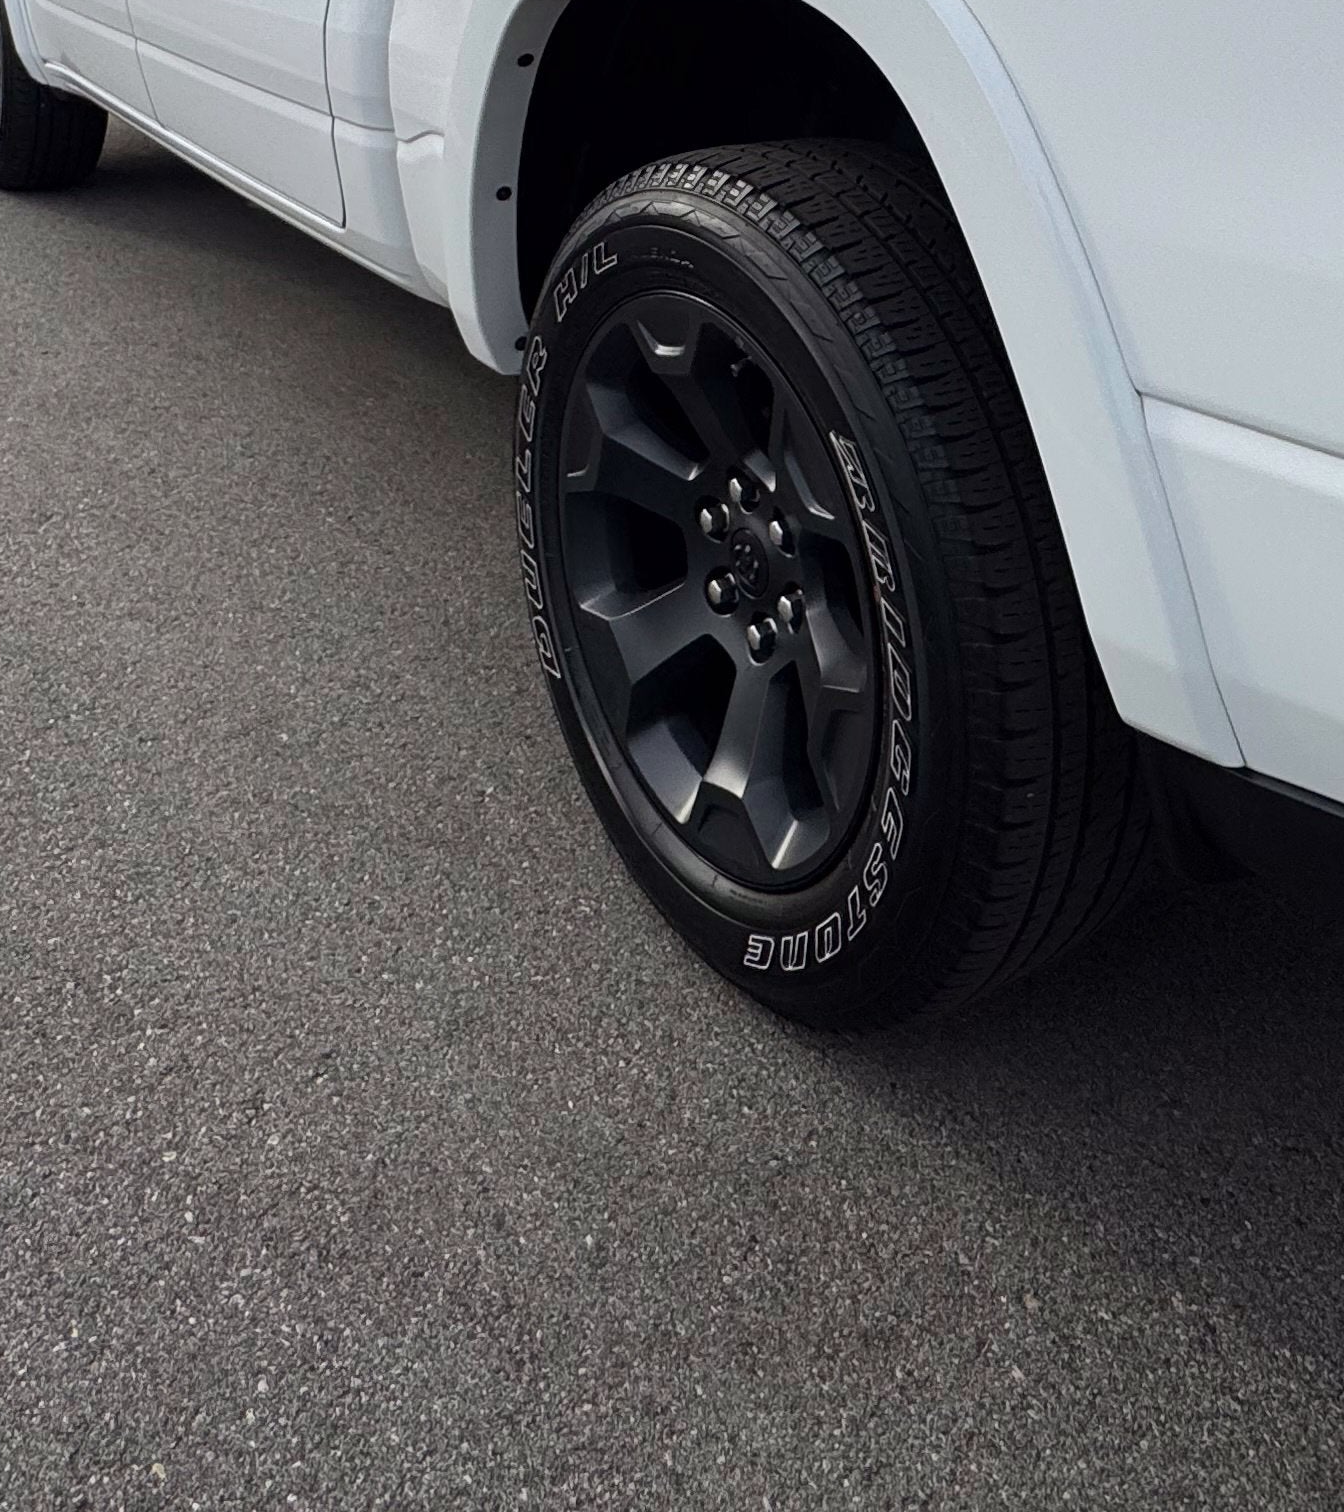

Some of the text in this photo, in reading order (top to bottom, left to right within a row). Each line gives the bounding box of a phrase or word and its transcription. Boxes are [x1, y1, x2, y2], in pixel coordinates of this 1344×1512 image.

[516, 240, 619, 680] DUELER H/L
[742, 430, 913, 972] BRIDGESTONE
